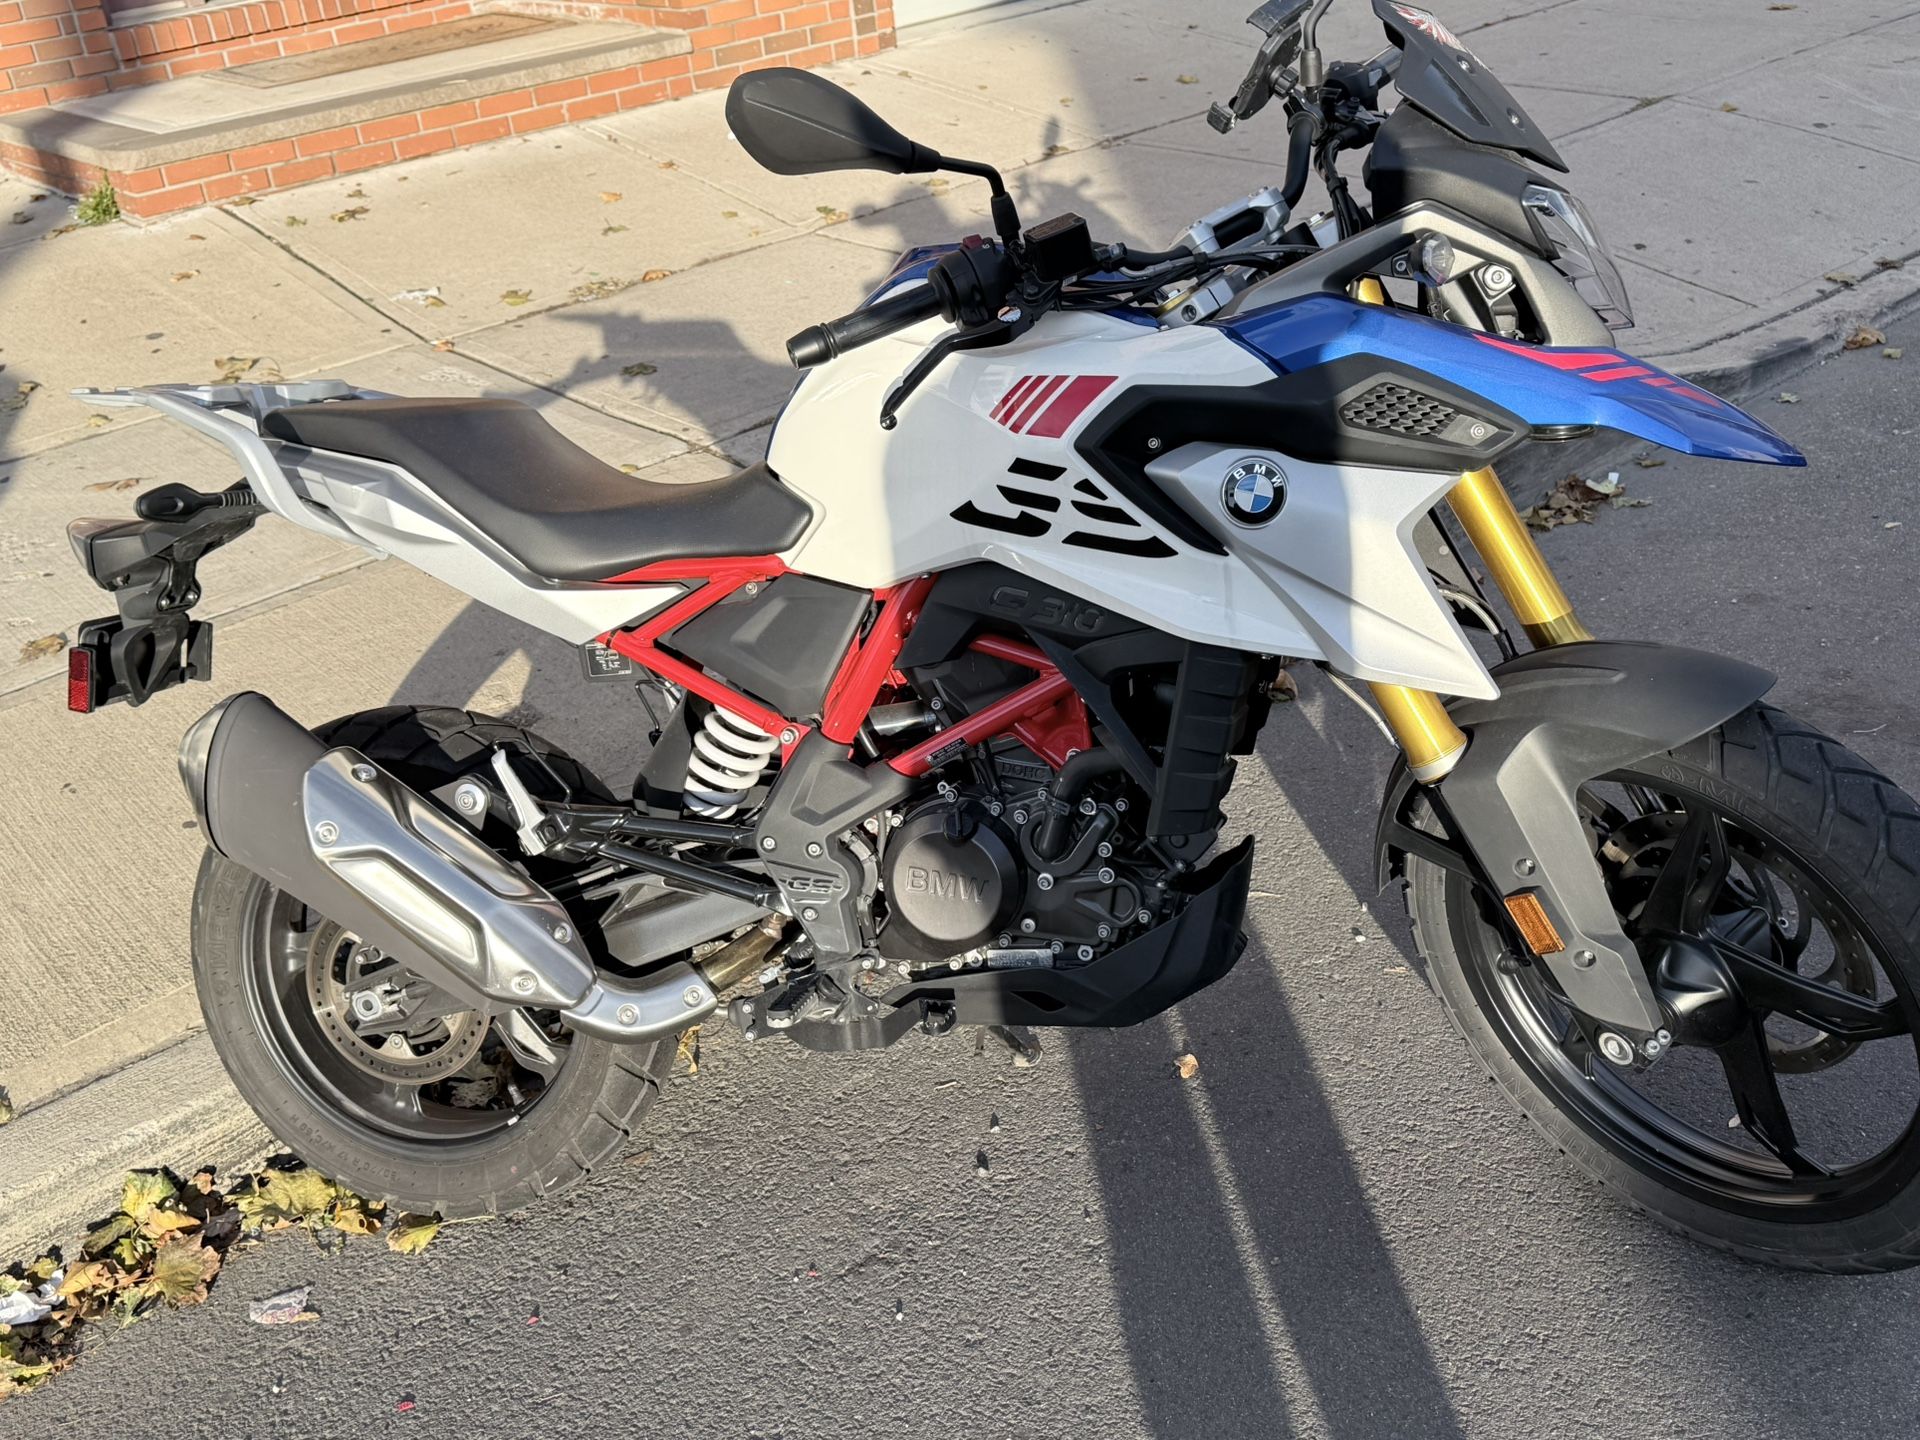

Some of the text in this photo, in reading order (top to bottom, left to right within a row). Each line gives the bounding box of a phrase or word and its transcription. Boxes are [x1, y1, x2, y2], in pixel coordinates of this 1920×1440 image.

[1233, 464, 1284, 488] BMW
[987, 585, 1108, 637] G 310
[1001, 763, 1045, 780] DOHC
[785, 874, 842, 894] GS
[905, 865, 990, 904] BMW
[1471, 1036, 1629, 1190] TOURANCE
